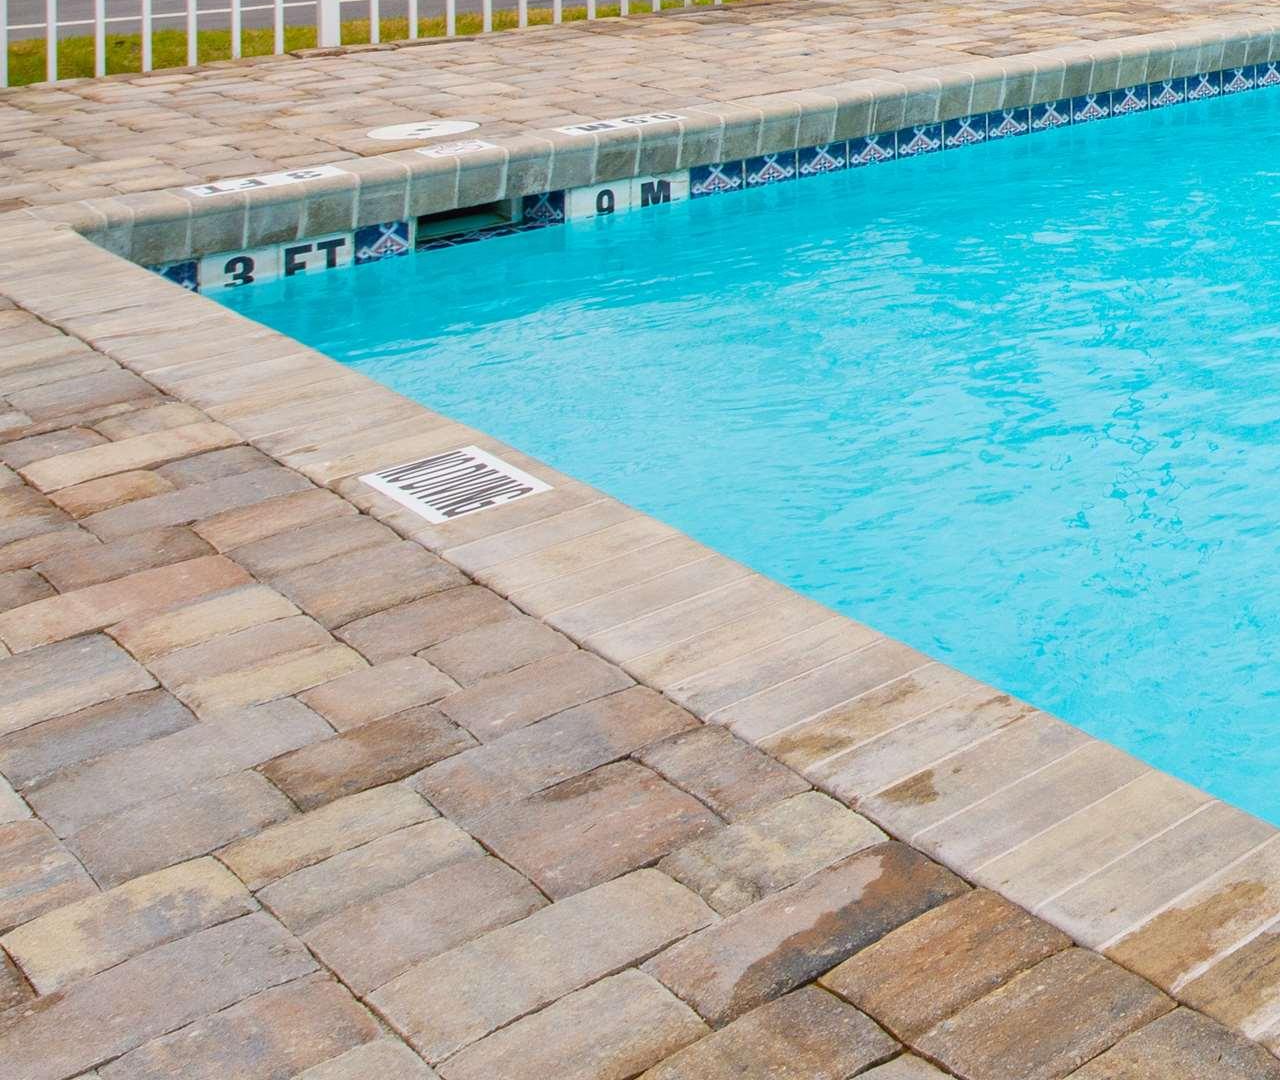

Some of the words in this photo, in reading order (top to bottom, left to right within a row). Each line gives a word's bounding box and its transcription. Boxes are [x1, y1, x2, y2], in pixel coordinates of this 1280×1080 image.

[224, 256, 255, 288] 3
[285, 237, 346, 277] FT
[398, 463, 534, 519] DIVING
